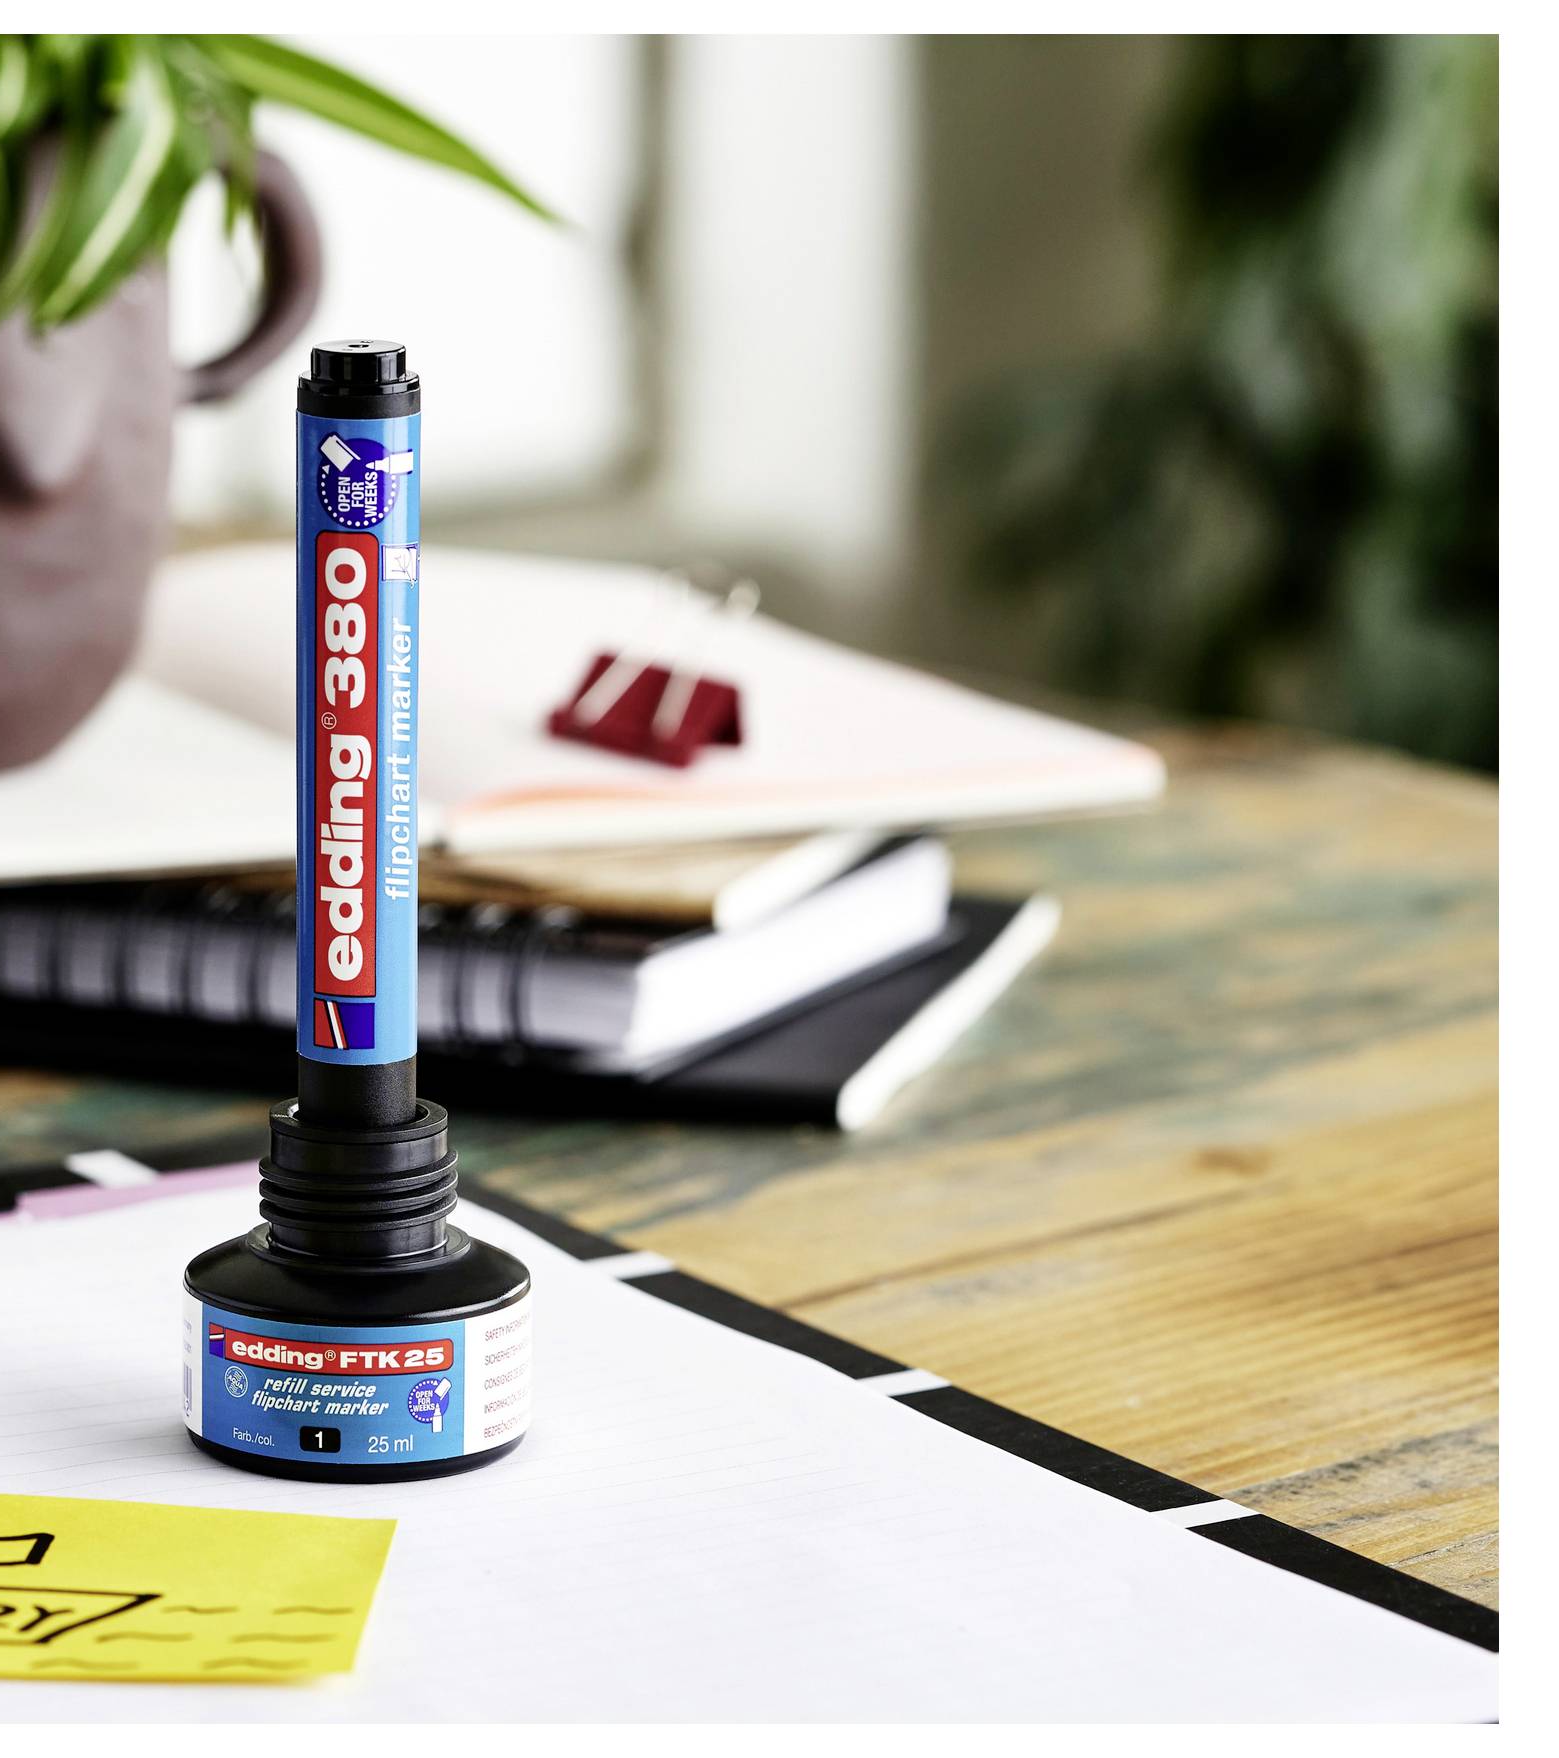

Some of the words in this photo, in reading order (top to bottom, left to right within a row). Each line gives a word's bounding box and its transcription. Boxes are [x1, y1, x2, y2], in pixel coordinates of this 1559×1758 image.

[338, 476, 351, 513] OPEN
[351, 481, 365, 508] FOR
[365, 471, 379, 518] WEEKS
[324, 547, 368, 709] 380
[386, 617, 412, 742] marker
[385, 754, 414, 900] flipchart
[340, 1350, 400, 1369] FTK
[403, 1346, 445, 1368] 25
[263, 1376, 308, 1395] refill
[310, 1381, 377, 1398] service
[415, 1391, 433, 1400] OPEN
[251, 1390, 321, 1414] flipchart
[324, 1399, 390, 1416] marker
[413, 1403, 435, 1412] WEEKS
[417, 1397, 431, 1405] FOR
[232, 1427, 275, 1447] Farb./col.
[314, 1430, 324, 1449] 1
[367, 1435, 390, 1454] 25
[393, 1433, 414, 1453] ml
